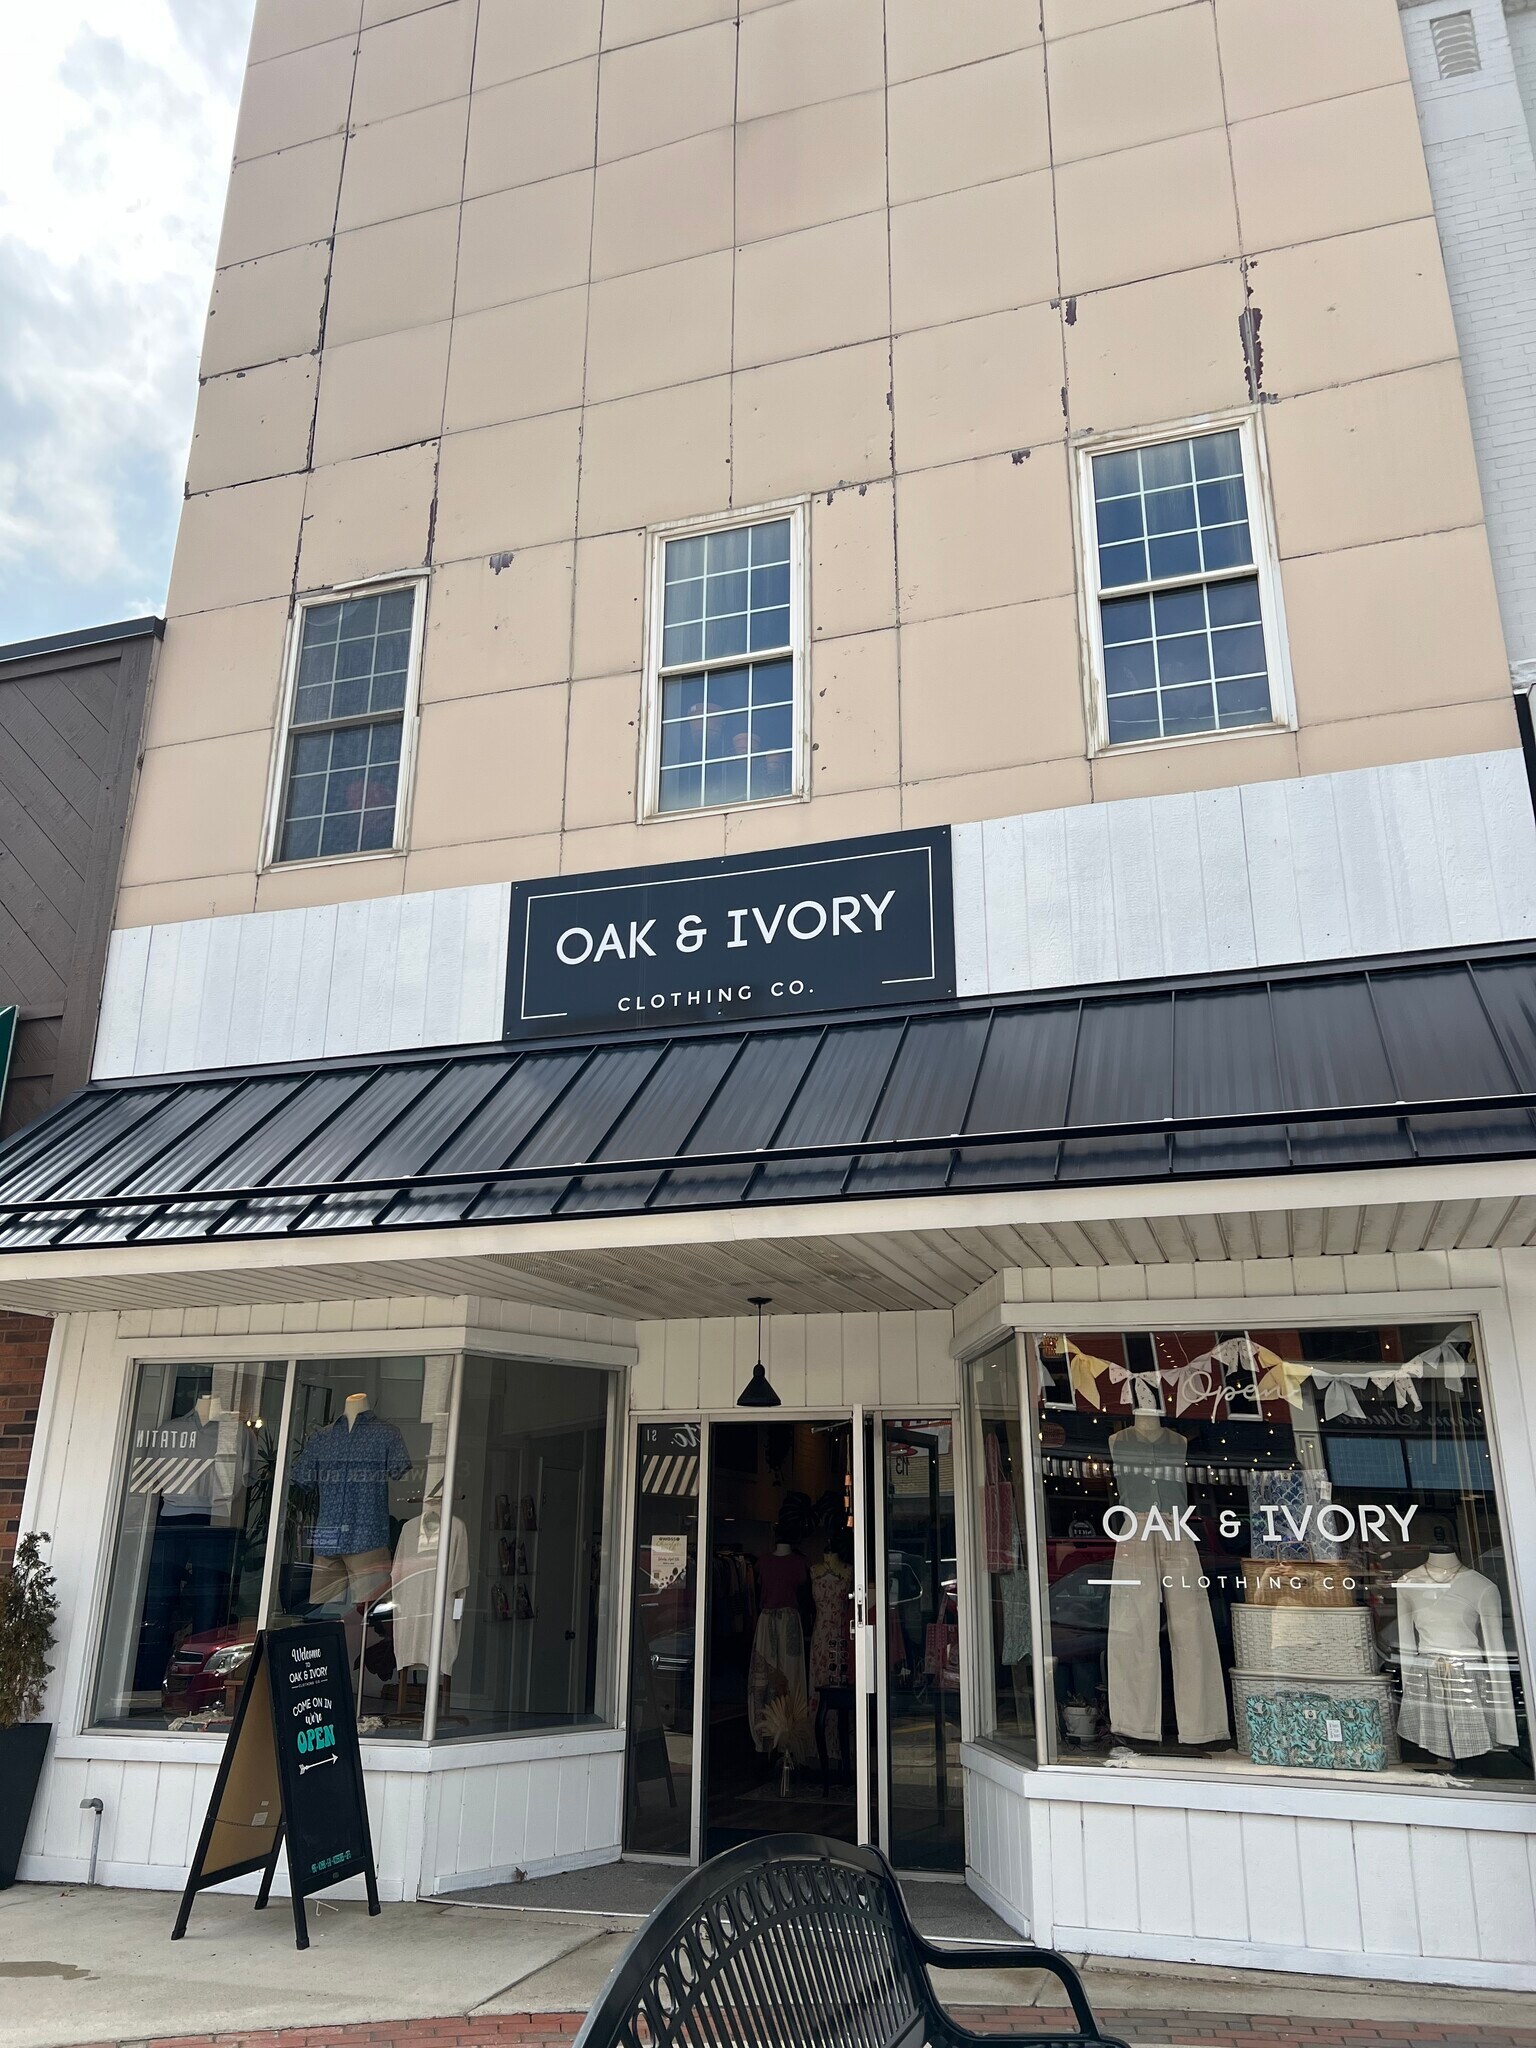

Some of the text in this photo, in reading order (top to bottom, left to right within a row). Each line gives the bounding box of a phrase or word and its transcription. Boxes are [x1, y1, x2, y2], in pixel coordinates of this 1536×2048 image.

[555, 890, 896, 966] OAK & IVORY
[618, 979, 815, 1013] CLOTHING CO.
[1182, 1370, 1301, 1423] Open
[1102, 1503, 1419, 1543] OAK & IVORY
[1162, 1575, 1370, 1591] CLOTHING CO.
[291, 1646, 322, 1662] Welcome
[289, 1666, 328, 1684] OAK & IVORY
[292, 1697, 333, 1717] COME ON IN
[297, 1724, 336, 1754] OPEN
